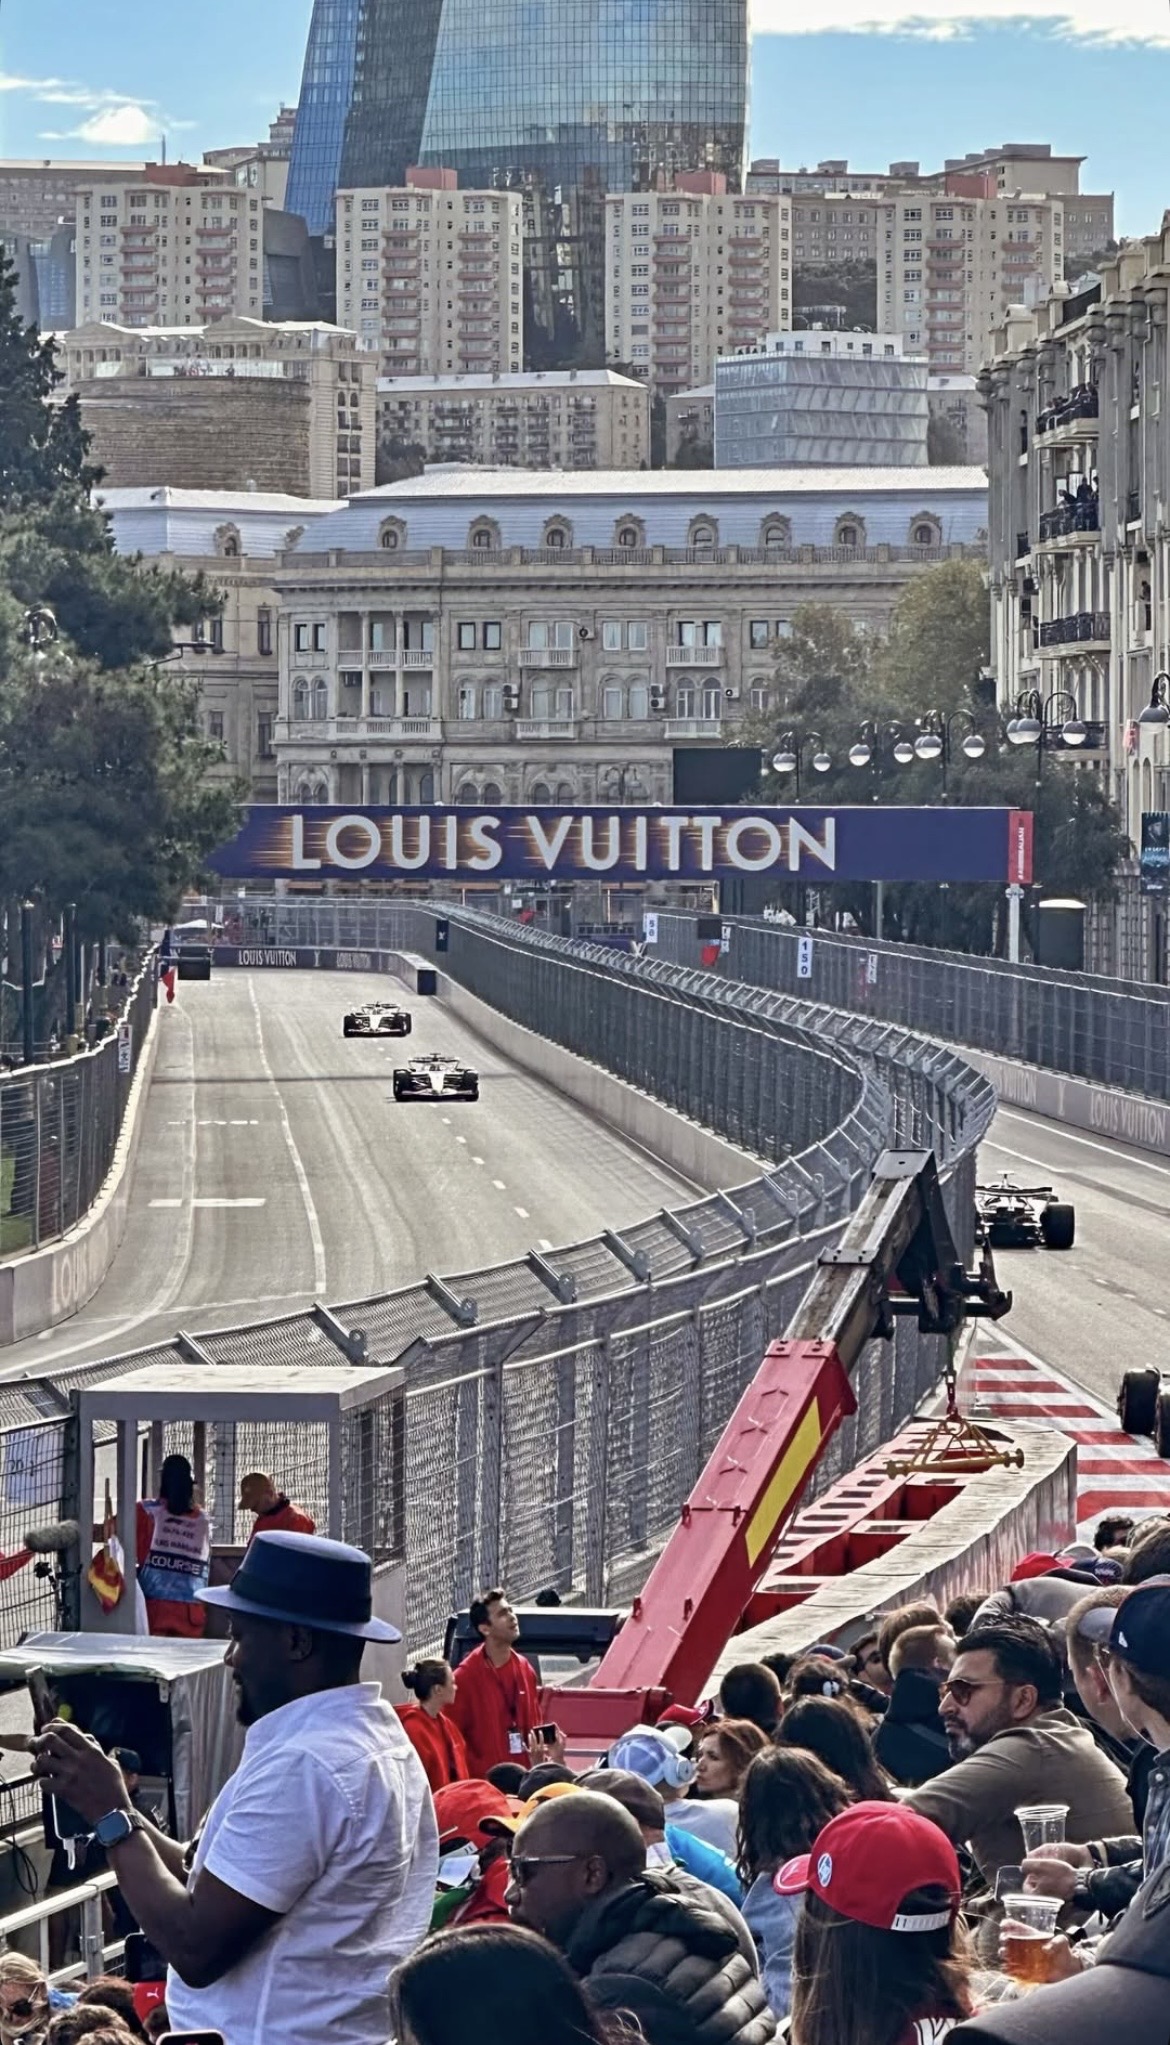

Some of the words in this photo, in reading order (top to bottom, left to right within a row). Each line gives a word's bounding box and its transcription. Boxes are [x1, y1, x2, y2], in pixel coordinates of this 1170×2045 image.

[293, 815, 502, 870] LOUIS
[527, 816, 835, 871] VUITTON
[238, 950, 263, 966] LOUIS
[264, 950, 297, 967] VUITTON
[801, 941, 809, 975] 150
[1090, 1090, 1118, 1132] LOUIS
[1120, 1099, 1167, 1146] VUITTON
